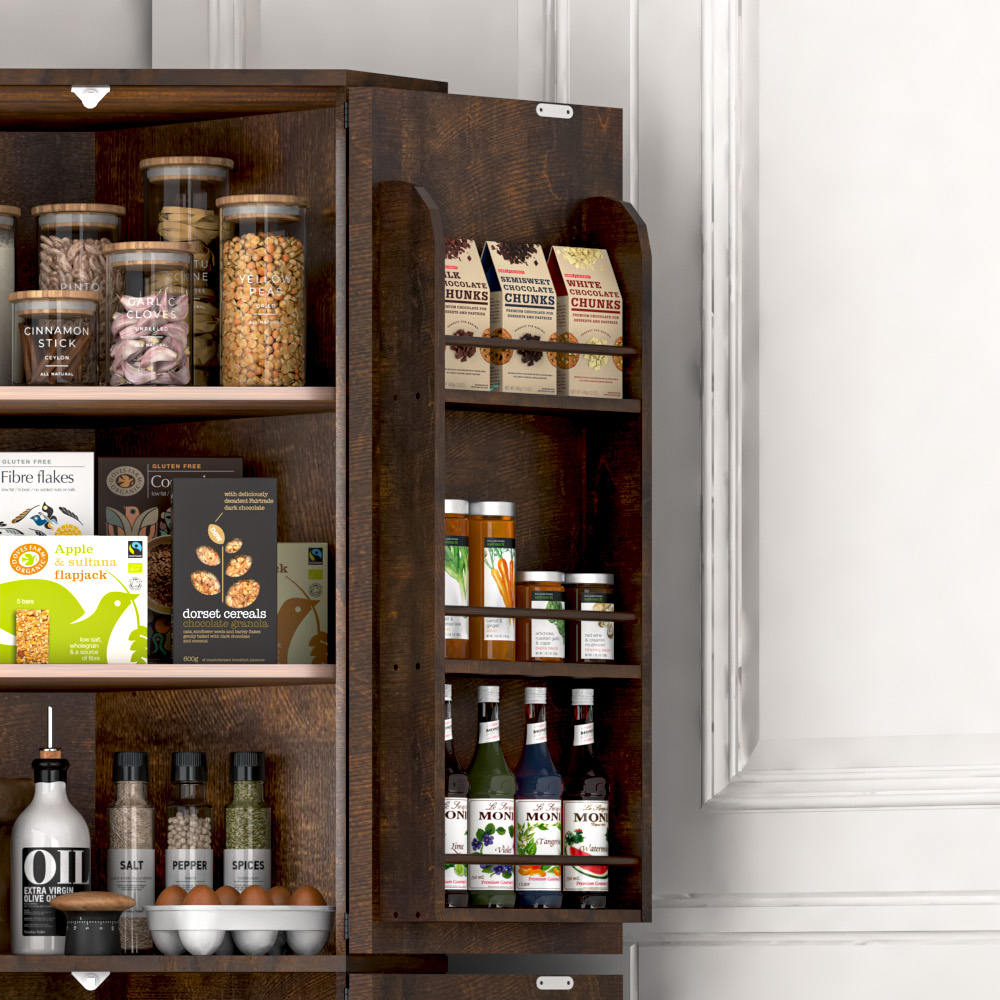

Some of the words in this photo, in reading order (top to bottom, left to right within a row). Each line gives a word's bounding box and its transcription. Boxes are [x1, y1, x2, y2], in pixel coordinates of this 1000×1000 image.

[239, 274, 292, 284] YELLOW
[500, 276, 550, 286] SEMISWEET
[60, 282, 100, 292] PINTO
[503, 285, 554, 294] CHOCOLATE
[566, 280, 602, 289] WHITE
[250, 288, 283, 297] PEAS
[570, 289, 620, 298] CHOCOLATE
[505, 293, 555, 305] CHUNKS
[571, 298, 620, 310] CHUNKS
[126, 310, 177, 319] CLOVES
[24, 326, 90, 336] CINNAMON
[38, 339, 76, 348] STICK
[1, 470, 33, 483] Fibre
[38, 470, 74, 483] flakes
[111, 484, 141, 494] ORGANIC
[12, 546, 28, 565] DOVES
[29, 545, 46, 558] FARM
[55, 544, 93, 556] Apple
[55, 558, 64, 566] &
[68, 557, 117, 566] sultana
[16, 560, 46, 574] ORGANIC
[55, 570, 107, 582] flapjack
[182, 608, 221, 619] dorset
[224, 608, 266, 619] cereals
[183, 619, 228, 628] chocolate
[231, 620, 269, 629] granola
[24, 849, 90, 885] OIL
[120, 861, 143, 870] SALT
[172, 861, 207, 870] PEPPER
[232, 861, 264, 870] SPICES
